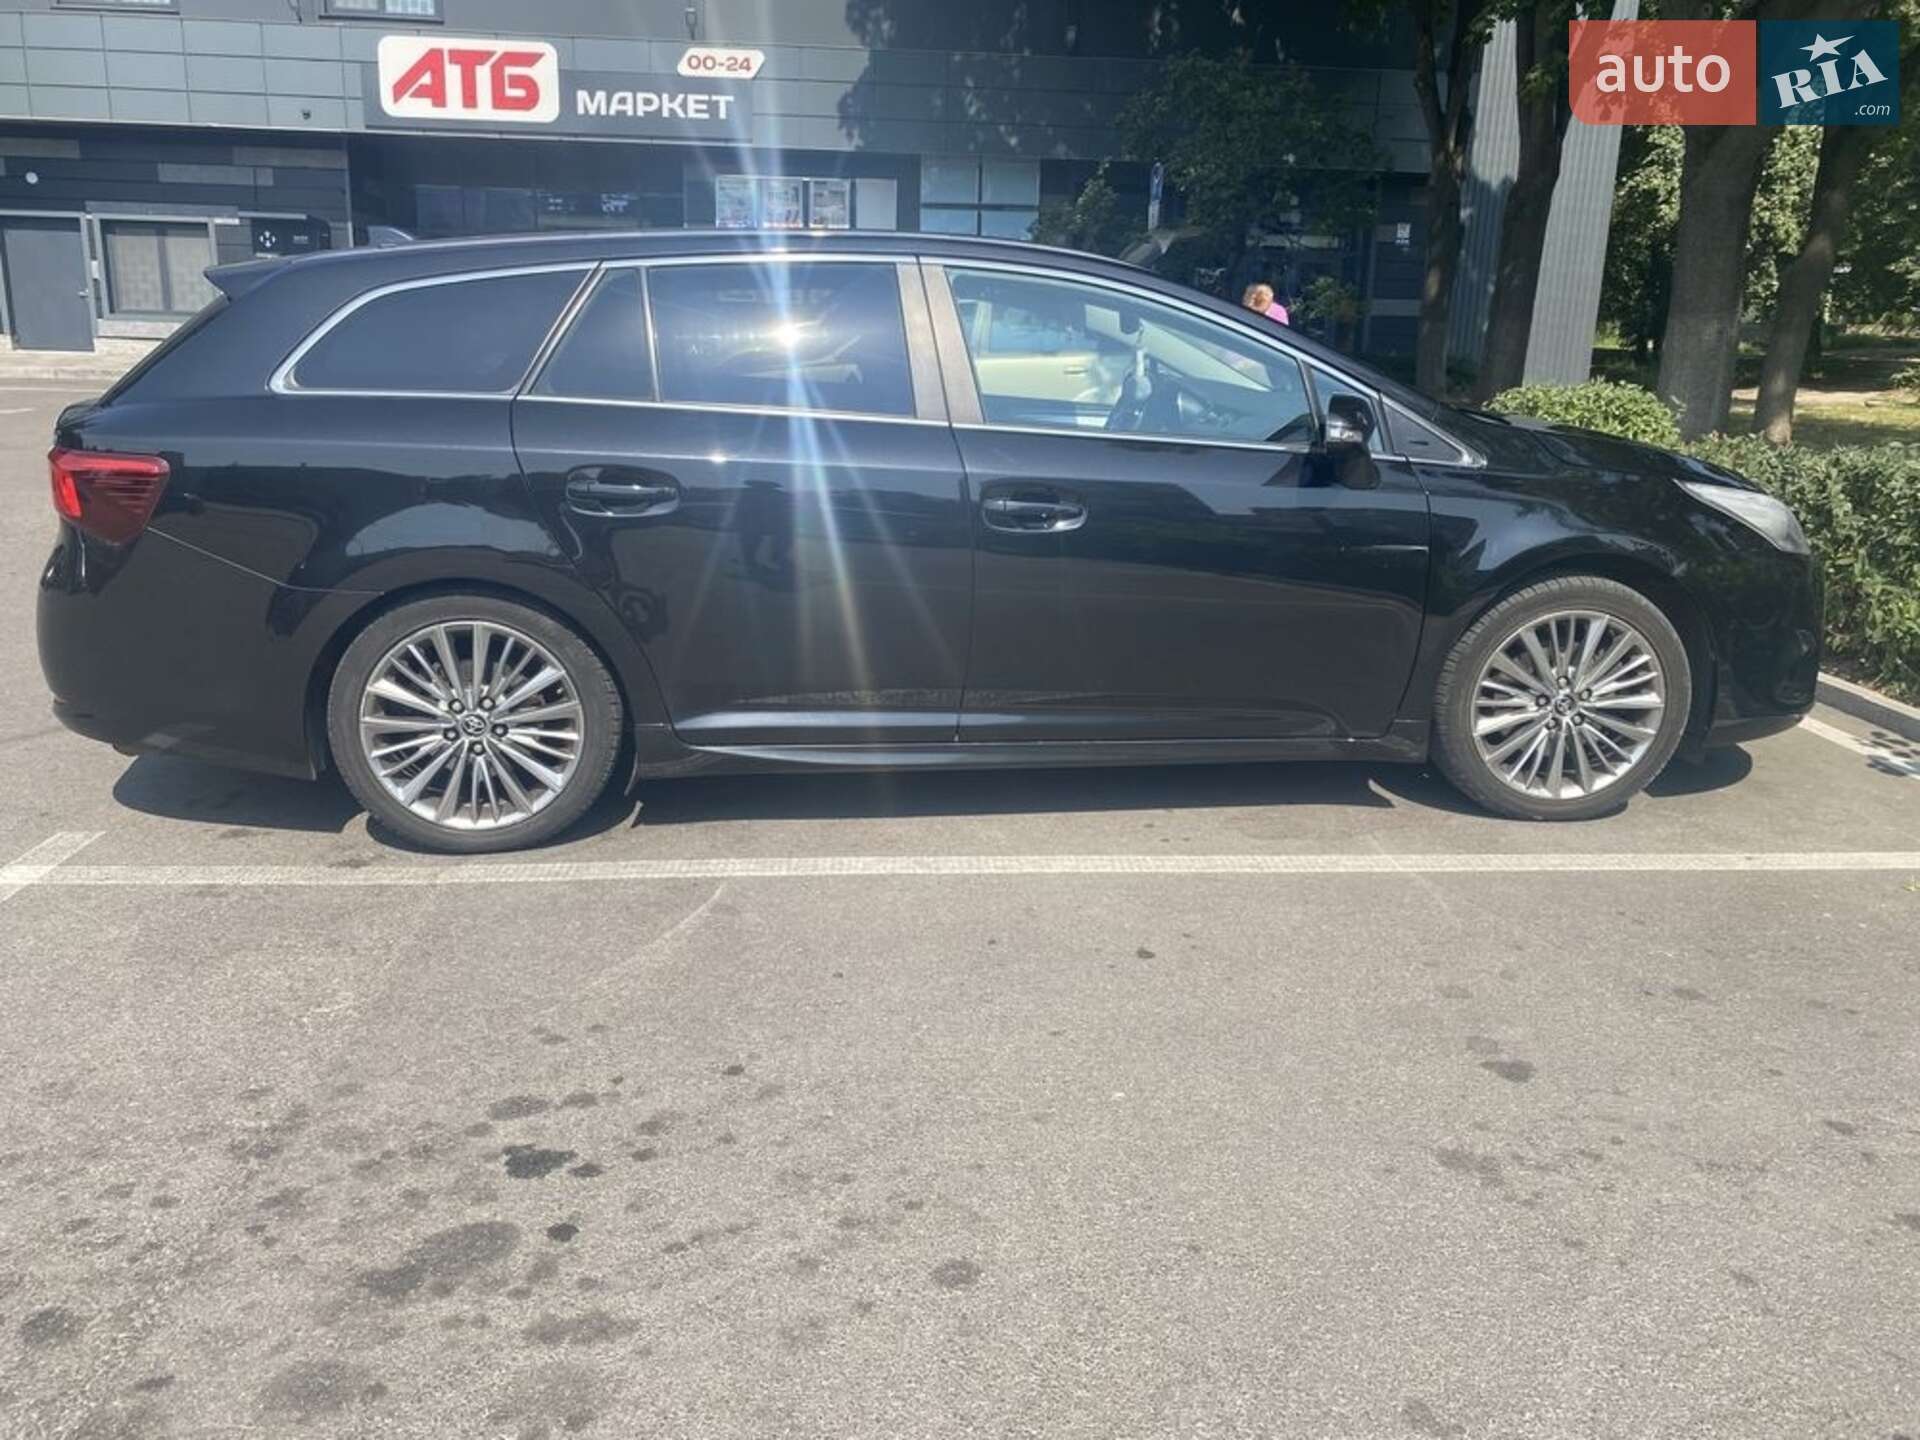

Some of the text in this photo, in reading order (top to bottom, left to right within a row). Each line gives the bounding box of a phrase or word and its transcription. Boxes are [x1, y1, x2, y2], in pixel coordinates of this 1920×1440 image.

[391, 47, 734, 120] АТБ МАРКЕТ
[687, 54, 753, 73] 00-24
